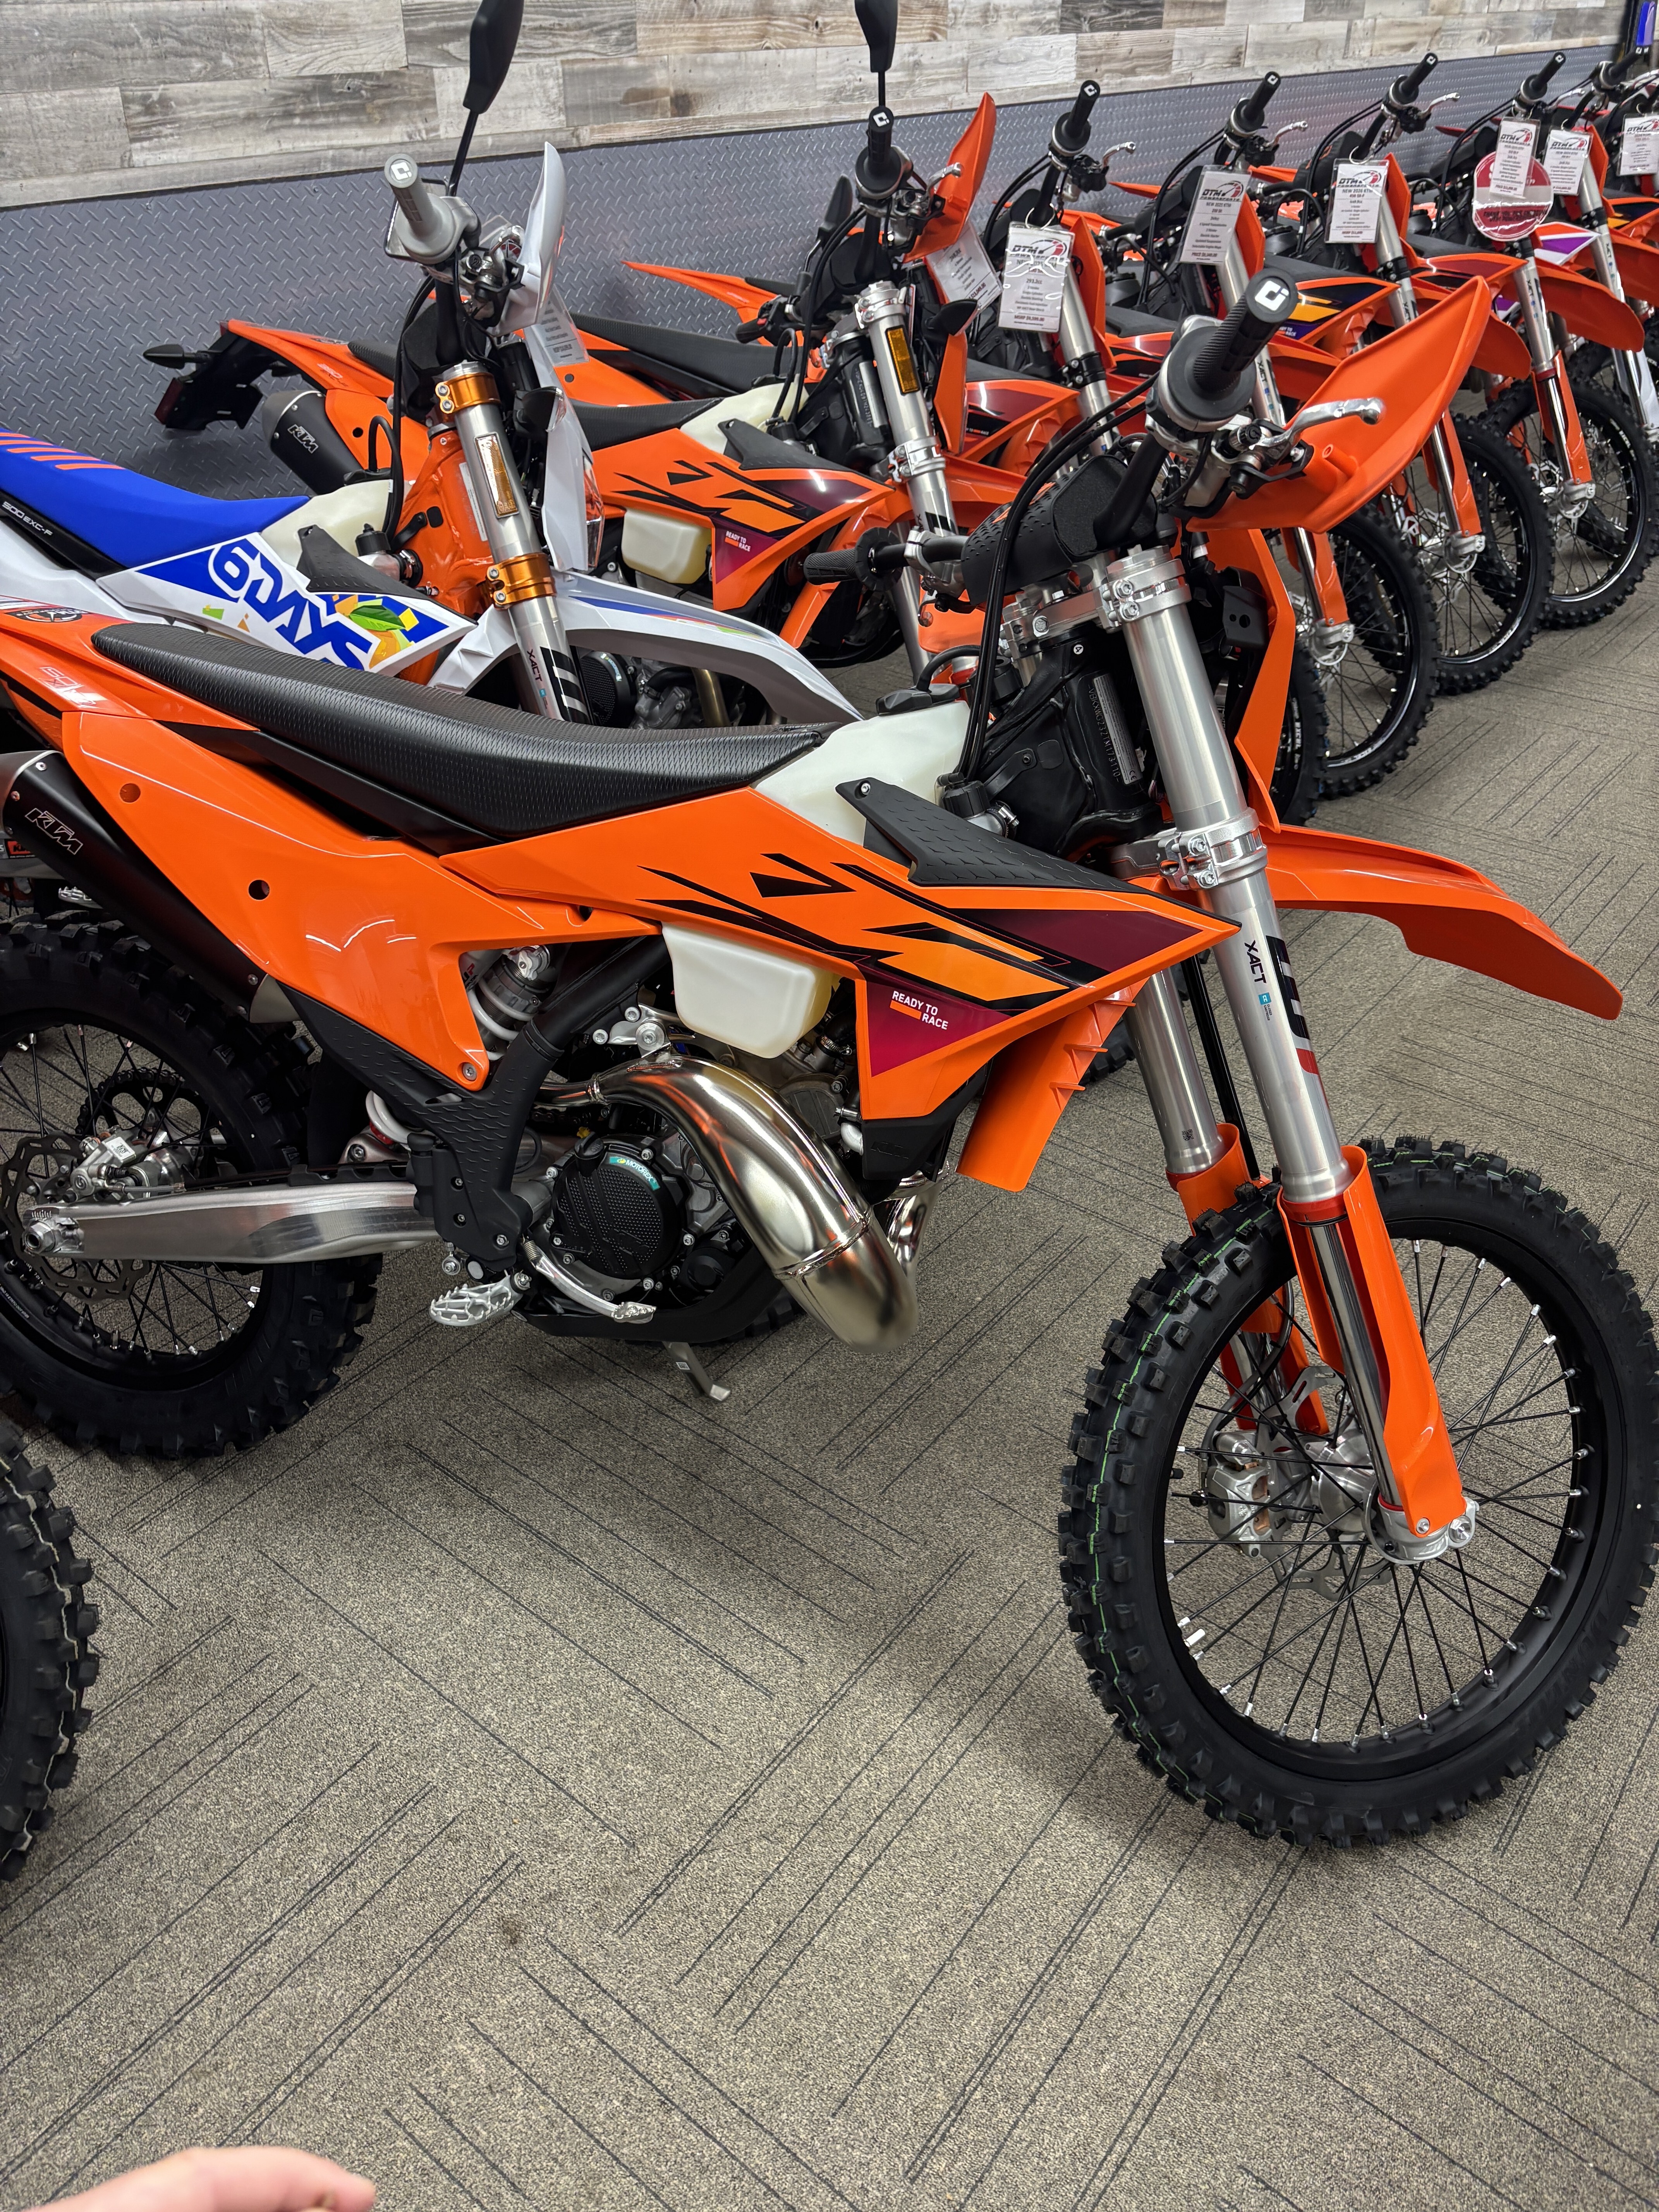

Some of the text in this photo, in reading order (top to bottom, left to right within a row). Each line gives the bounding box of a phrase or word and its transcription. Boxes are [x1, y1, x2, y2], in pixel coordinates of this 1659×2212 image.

[1202, 189, 1223, 197] DTM
[1012, 245, 1039, 254] DTM
[1257, 361, 1267, 382] XACT
[287, 424, 319, 453] KTM
[726, 531, 739, 541] READY
[738, 542, 751, 552] RACE
[527, 649, 543, 682] XACT
[1129, 770, 1137, 781] CE
[24, 807, 84, 855] KTM
[1244, 939, 1267, 984] XACT
[892, 990, 938, 1016] READY TO
[922, 1013, 949, 1030] RACE
[625, 1159, 654, 1182] MOTOREX
